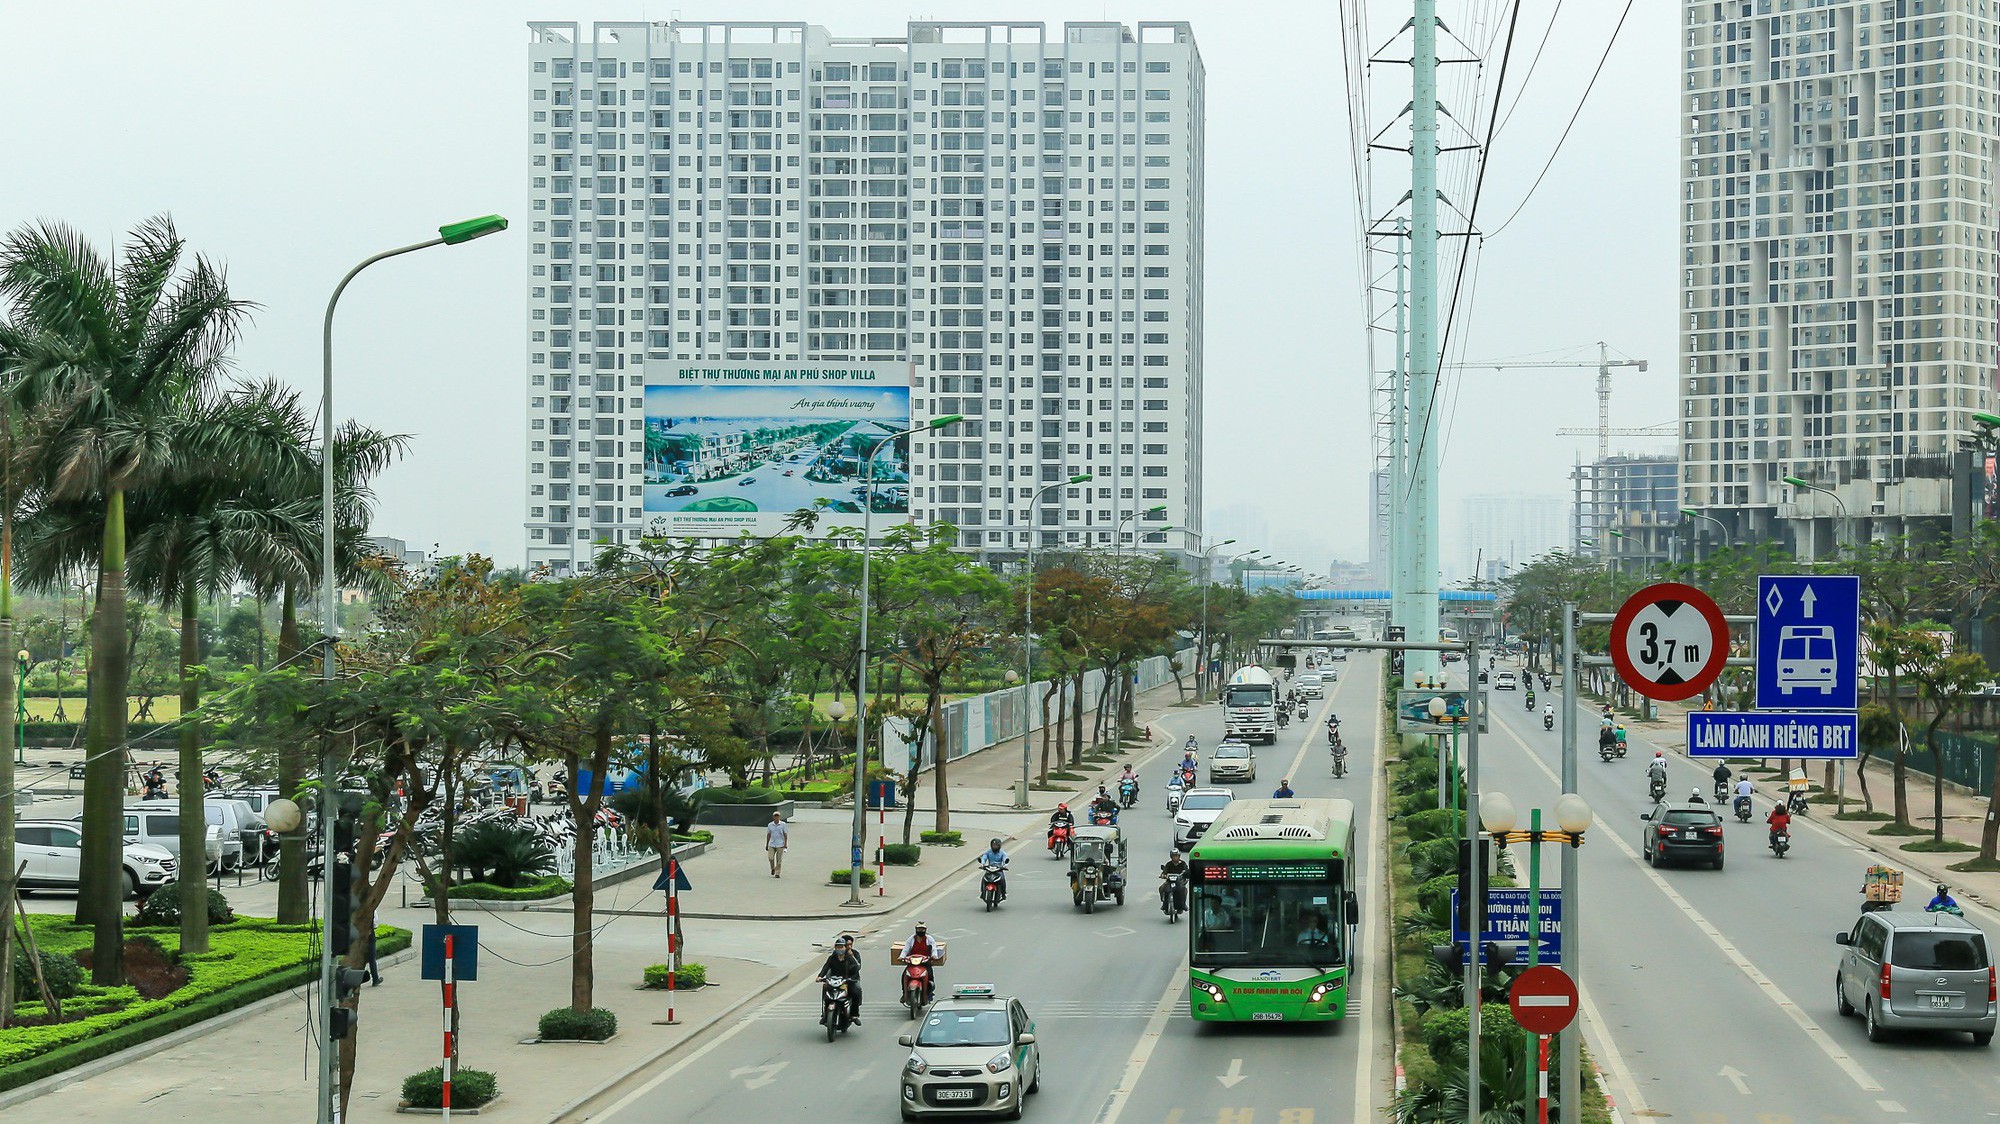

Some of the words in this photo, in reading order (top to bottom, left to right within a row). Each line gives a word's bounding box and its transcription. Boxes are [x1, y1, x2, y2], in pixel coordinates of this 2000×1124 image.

[679, 367, 699, 381] BIỆT
[702, 368, 721, 381] THỰ
[723, 368, 760, 380] THƯƠNG
[763, 369, 781, 381] MẠI
[784, 369, 797, 380] AN
[800, 367, 819, 380] PHÚ
[822, 369, 847, 380] SHOP
[850, 370, 876, 380] VILLA
[790, 398, 810, 410] An
[809, 400, 825, 411] gia
[1684, 643, 1700, 663] m
[1696, 717, 1725, 748] LÀN
[1729, 718, 1770, 748] DÀNH
[1774, 719, 1819, 749] RIÊNG
[1822, 725, 1851, 749] BRT
